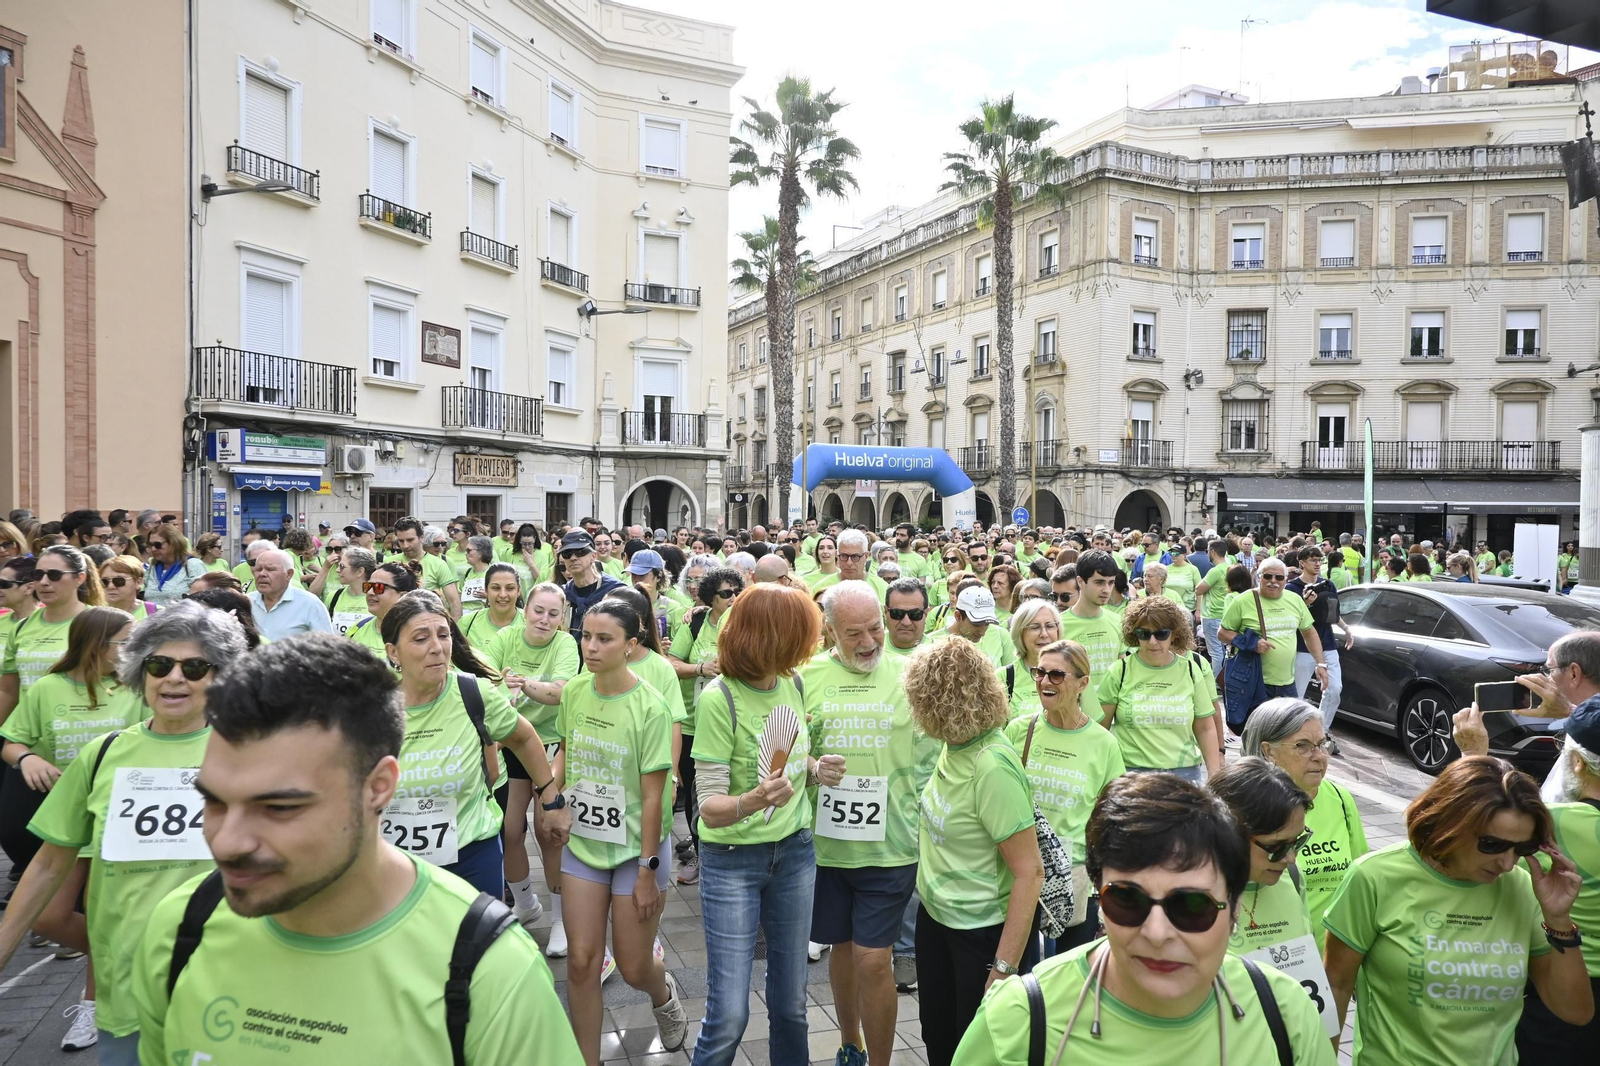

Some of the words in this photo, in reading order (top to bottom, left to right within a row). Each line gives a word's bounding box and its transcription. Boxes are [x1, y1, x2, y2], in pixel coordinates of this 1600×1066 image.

[463, 458, 471, 475] LA
[474, 458, 510, 477] TRAVIESA
[835, 452, 884, 467] Huelva
[888, 454, 934, 471] original
[823, 701, 840, 712] En
[844, 700, 894, 713] marcha
[1133, 704, 1174, 713] contra
[1176, 704, 1188, 713] el
[53, 720, 70, 730] En
[74, 716, 125, 728] marcha
[824, 715, 876, 729] contra
[879, 716, 892, 730] el
[1134, 712, 1189, 725] cáncer
[573, 729, 583, 742] En
[586, 735, 628, 755] marcha
[824, 730, 891, 748] cáncer
[405, 745, 463, 762] marcha
[445, 760, 464, 776] el
[610, 758, 623, 770] el
[1027, 760, 1044, 770] En
[1045, 764, 1088, 782] marcha
[395, 778, 465, 799] áncer
[1033, 786, 1081, 808] áncer
[1072, 784, 1085, 796] el
[1302, 840, 1340, 856] aecc
[170, 862, 197, 870] HUELVA
[1306, 857, 1333, 865] HUELVA
[1303, 866, 1320, 875] en
[1269, 920, 1289, 928] española
[1426, 935, 1449, 952] En
[1454, 938, 1525, 955] marcha
[1408, 935, 1425, 1007] HUELVA
[1427, 959, 1504, 978] contra
[1506, 959, 1526, 979] el
[1427, 978, 1524, 1001] cáncer
[246, 1007, 297, 1025] asociación
[300, 1018, 348, 1035] española
[242, 1020, 272, 1035] contra
[274, 1026, 284, 1037] el
[286, 1029, 322, 1045] cáncer
[253, 1036, 291, 1053] Huelva
